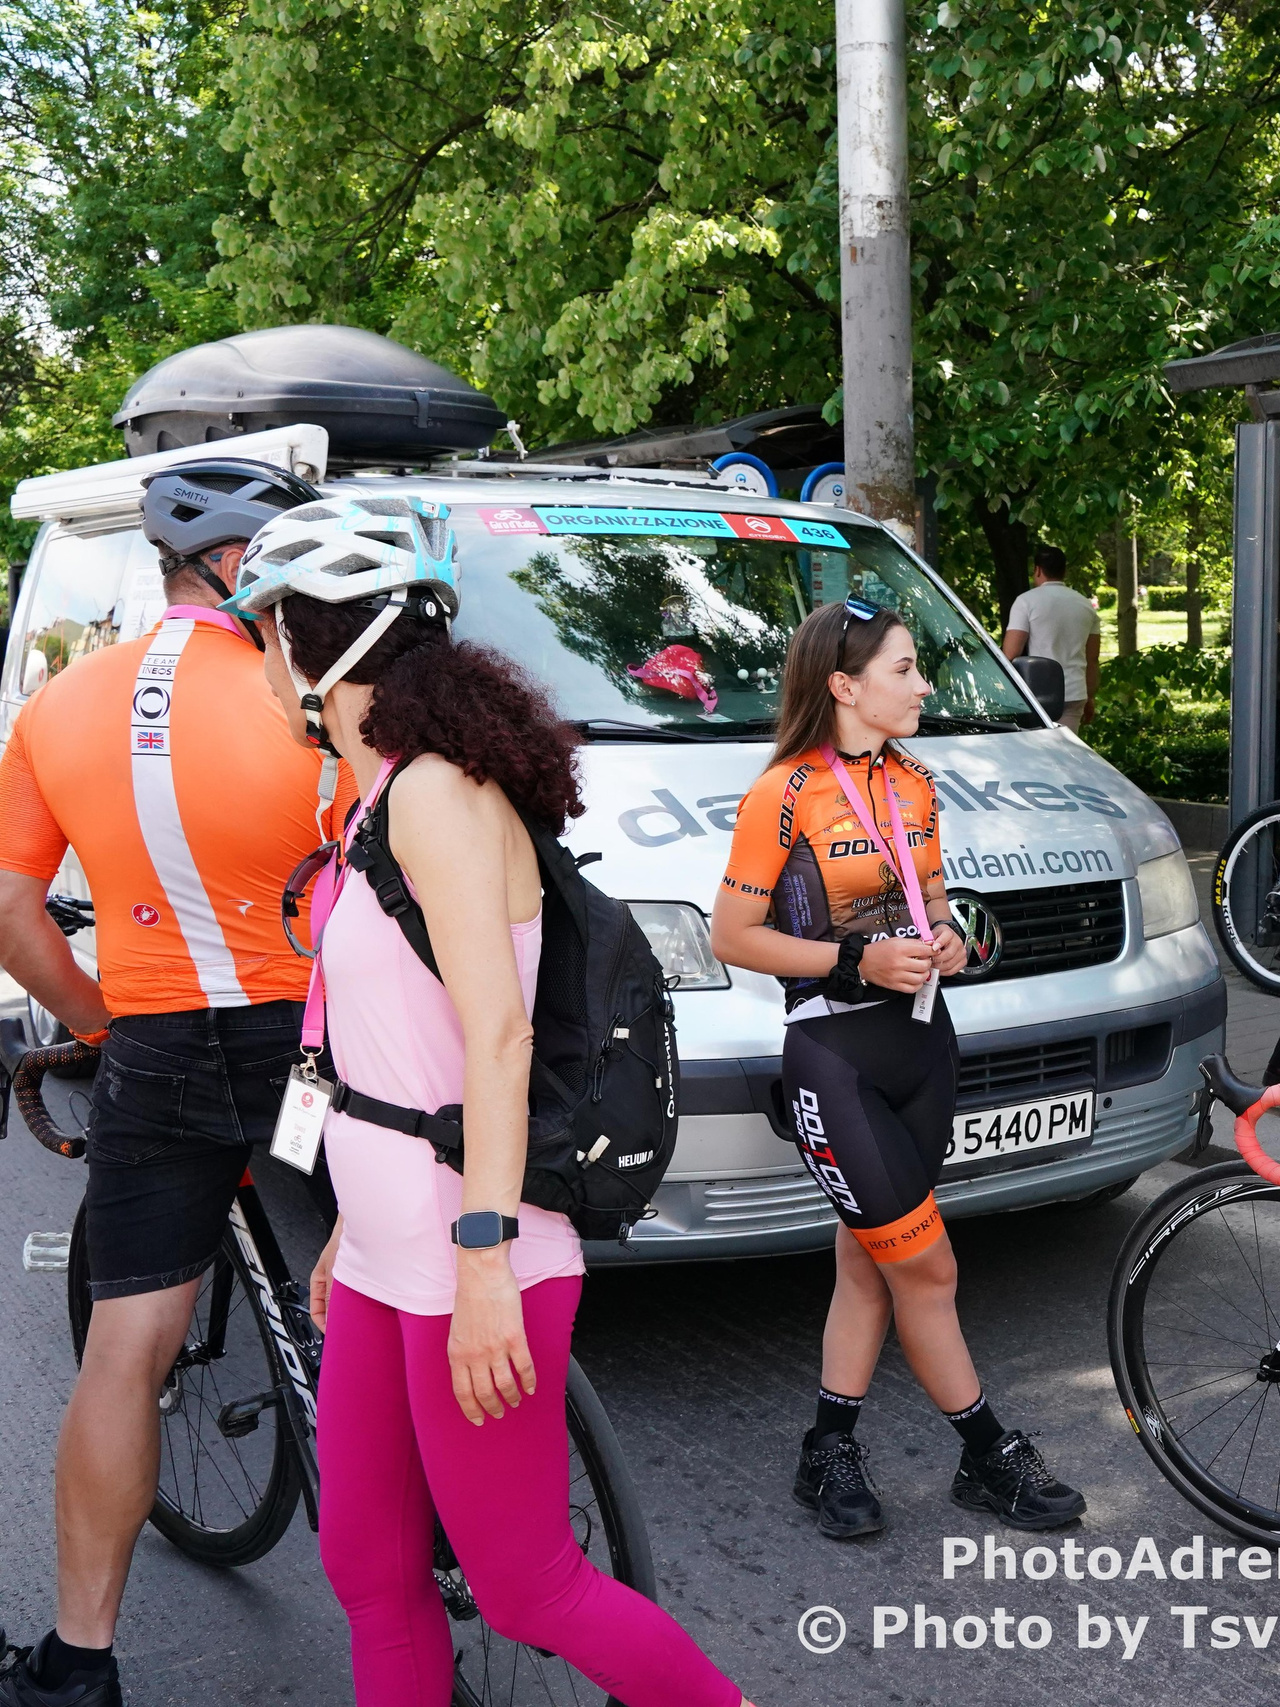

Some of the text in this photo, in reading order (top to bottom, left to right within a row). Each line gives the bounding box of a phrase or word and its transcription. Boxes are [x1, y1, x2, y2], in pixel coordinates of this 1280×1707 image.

[173, 487, 209, 504] SMITH
[545, 513, 727, 531] ORGANIZZAZIONE
[801, 525, 835, 541] 436
[146, 657, 176, 666] TEAM
[142, 666, 172, 677] INEOS
[778, 761, 817, 850] DOLTCINI
[1215, 859, 1227, 906] MAXXIS
[852, 893, 876, 908] HOT
[964, 1107, 1042, 1156] 5440
[1048, 1097, 1088, 1140] PM
[618, 1151, 648, 1168] HELIUM
[799, 1087, 863, 1216] DOLTCINI
[868, 1206, 942, 1252] HOT SPRIN
